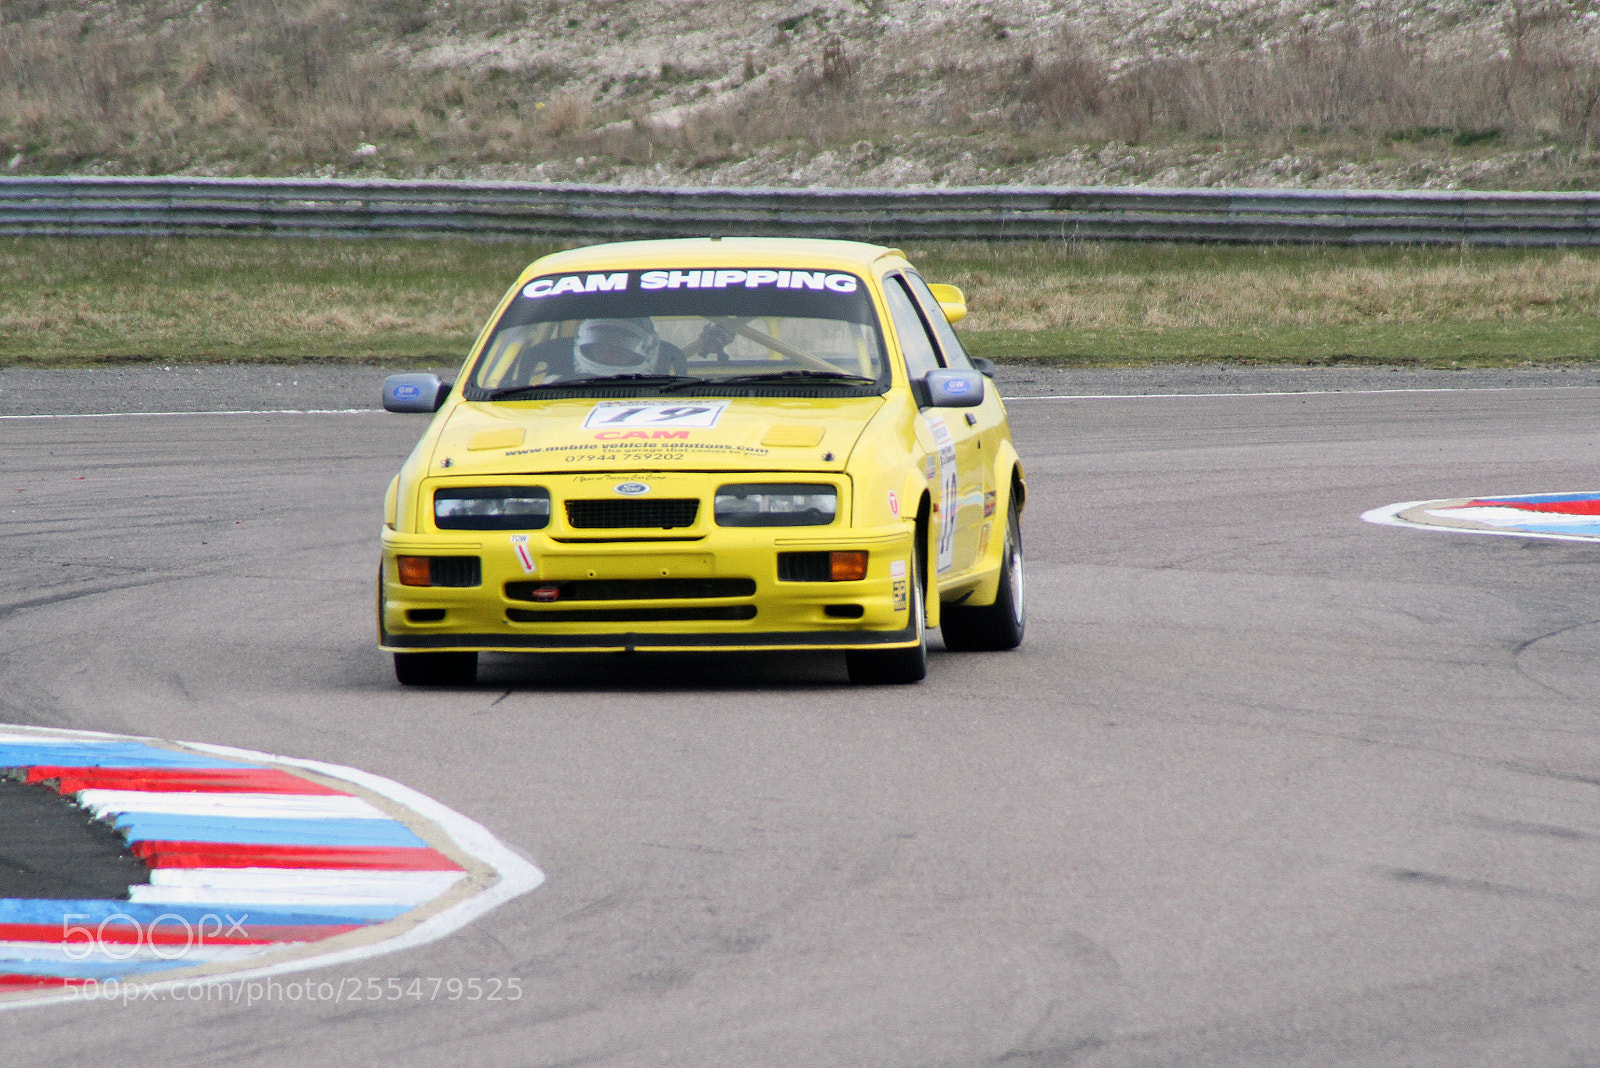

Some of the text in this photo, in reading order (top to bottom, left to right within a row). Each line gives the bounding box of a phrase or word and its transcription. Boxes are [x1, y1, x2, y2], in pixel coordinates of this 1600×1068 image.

[522, 270, 858, 298] CAM SHIPPING
[599, 406, 712, 423] 19
[594, 430, 690, 440] CAM
[661, 442, 769, 454] solutions.com
[565, 453, 684, 463] 07944 759202
[511, 534, 527, 542] TOW
